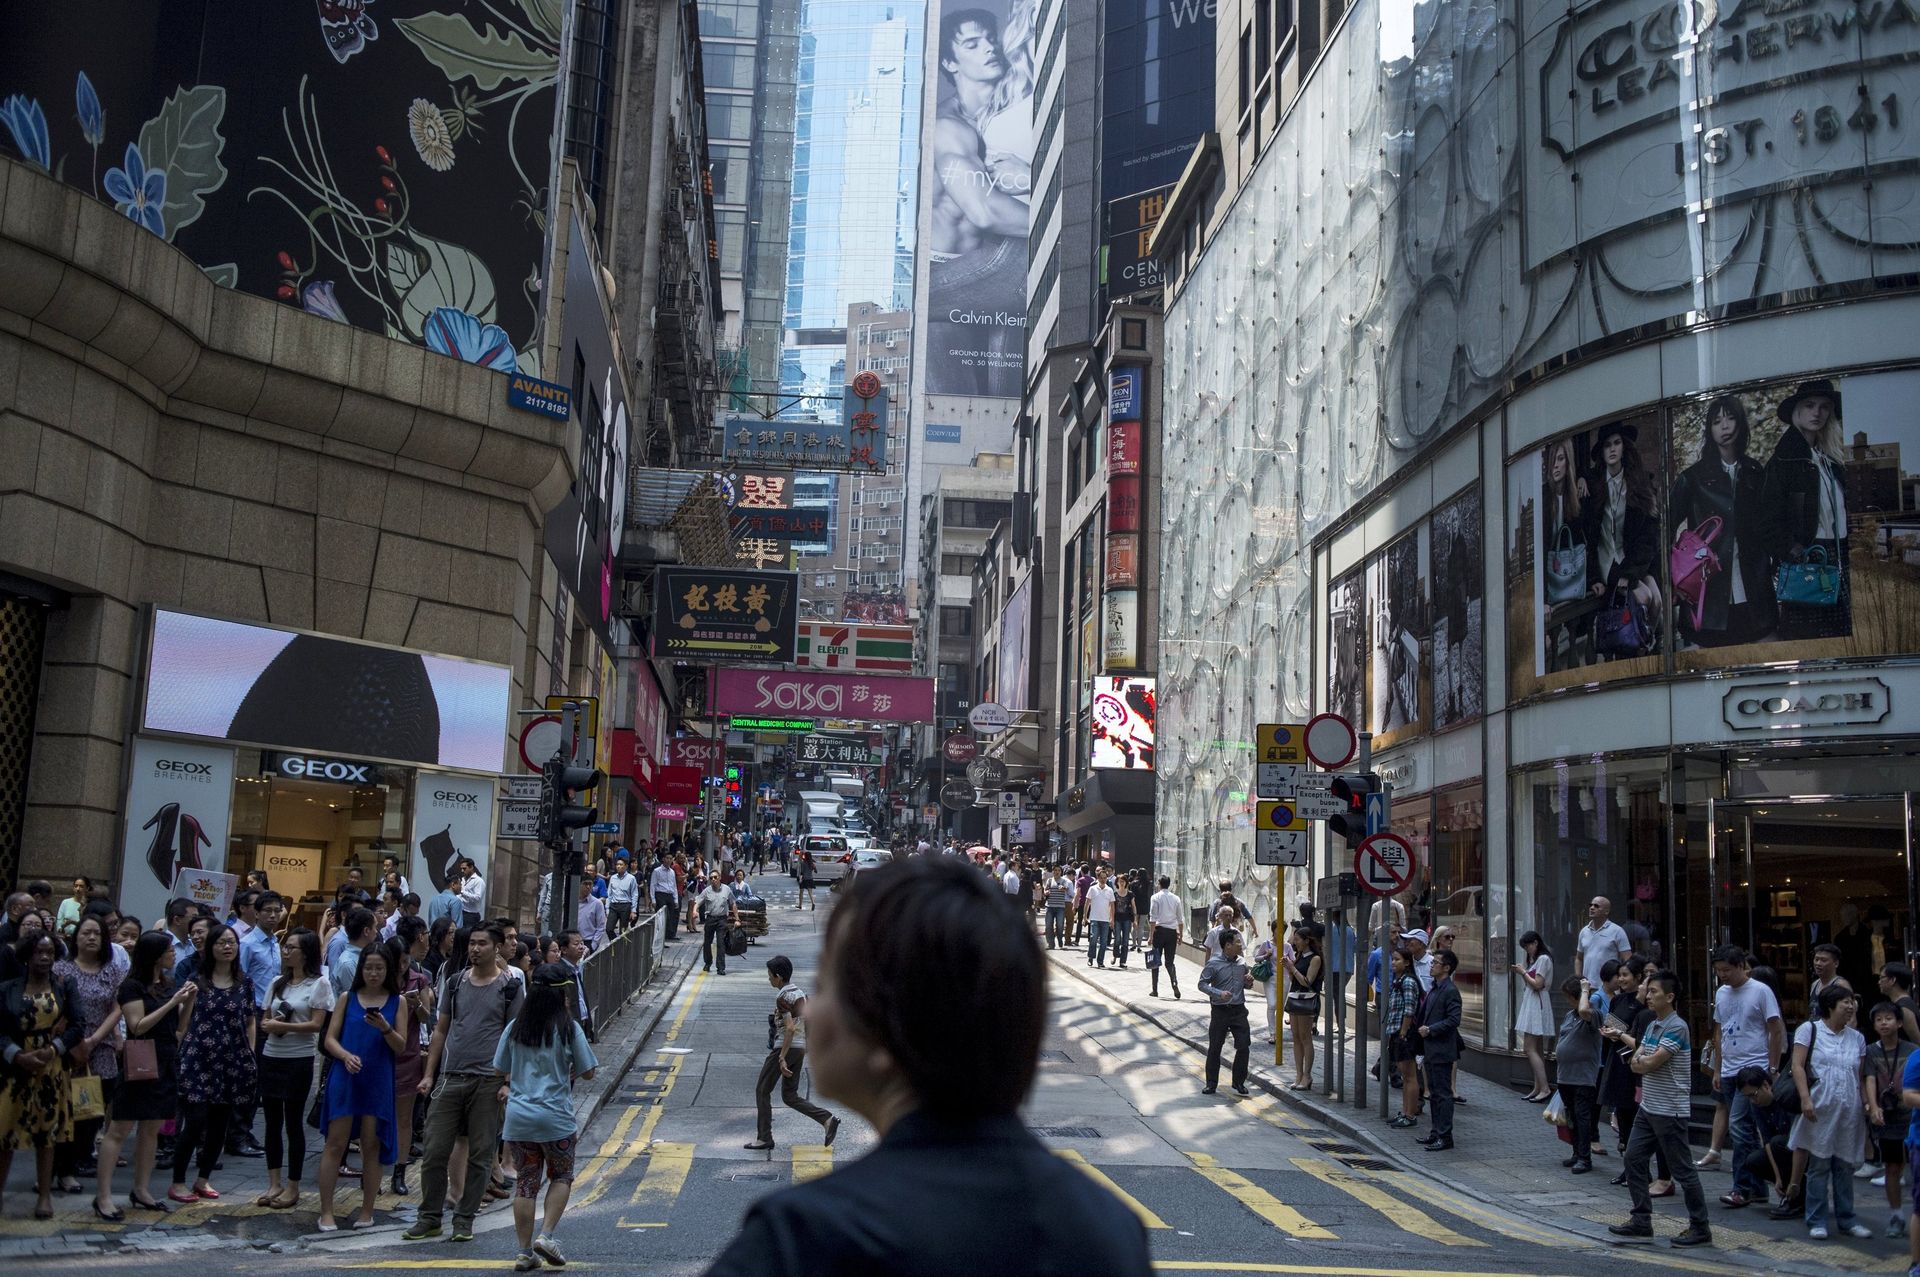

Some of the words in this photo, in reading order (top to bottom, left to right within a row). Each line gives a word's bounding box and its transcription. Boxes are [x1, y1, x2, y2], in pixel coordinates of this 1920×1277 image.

[1790, 93, 1897, 147] 1941
[1142, 154, 1149, 163] by
[1150, 148, 1176, 160] Standard
[949, 309, 992, 325] Calvin
[996, 311, 1026, 327] Klein
[949, 349, 979, 357] GROUND
[513, 378, 569, 404] AVANTI
[526, 396, 546, 409] 2117
[547, 403, 567, 415] 8182
[755, 675, 842, 712] Sasa
[852, 685, 892, 712] 莎莎
[1737, 692, 1873, 715] COACH
[732, 719, 758, 727] CENTRAL
[758, 720, 785, 728] MEDICINE
[785, 721, 813, 729] COMPANY
[804, 737, 819, 745] Italy
[803, 744, 868, 762] 意大利站
[156, 759, 212, 775] GEOX
[282, 757, 369, 782] GEOX
[1289, 766, 1297, 777] 7
[154, 771, 212, 783] BREATHES
[433, 790, 478, 804] GEOX
[1300, 791, 1323, 799] Except
[432, 801, 478, 811] BREATHES
[505, 806, 531, 814] Except
[1289, 833, 1297, 844] 7
[269, 856, 308, 867] GEOX
[1289, 851, 1297, 862] 7
[268, 865, 308, 873] BREATHES
